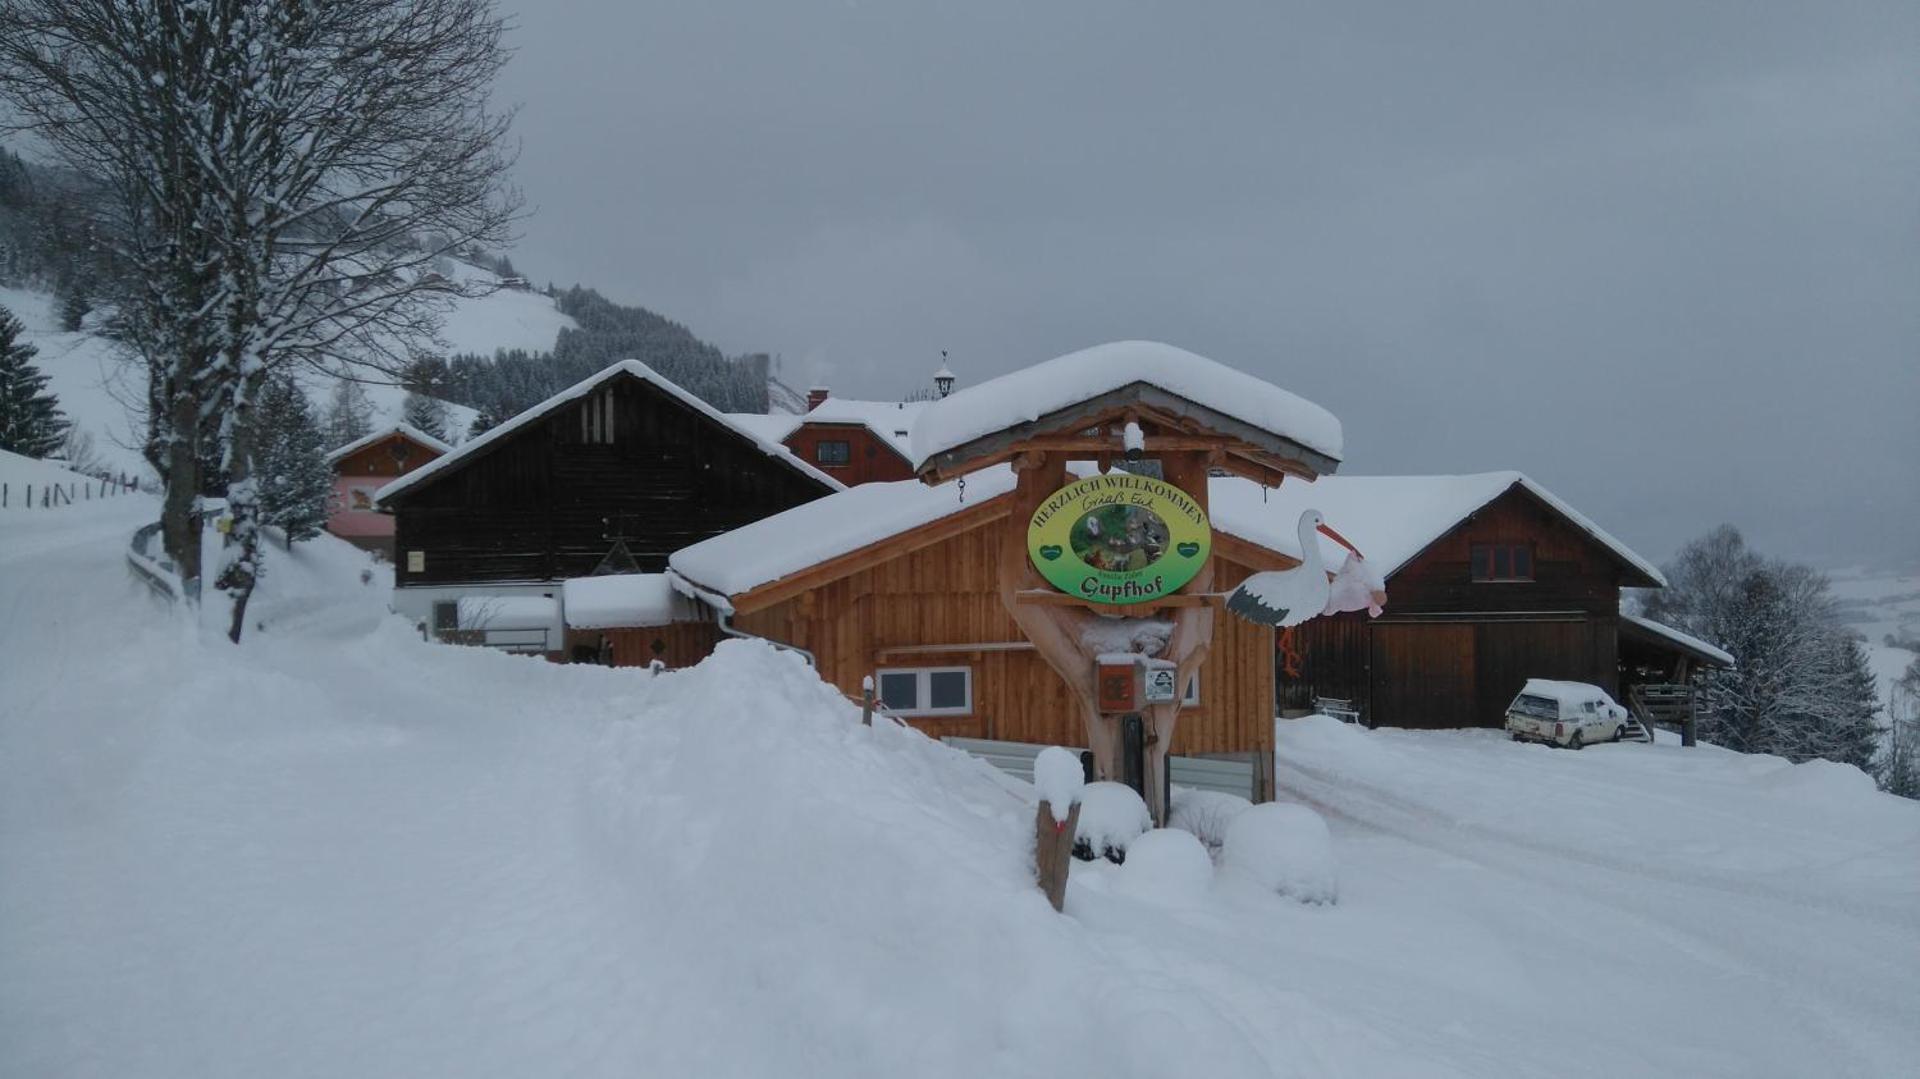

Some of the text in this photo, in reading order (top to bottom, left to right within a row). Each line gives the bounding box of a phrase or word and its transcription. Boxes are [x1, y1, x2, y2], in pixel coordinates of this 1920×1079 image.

[1033, 477, 1205, 528] HERZLICH WILLKOMMEN
[1080, 575, 1163, 600] Gupfhof
